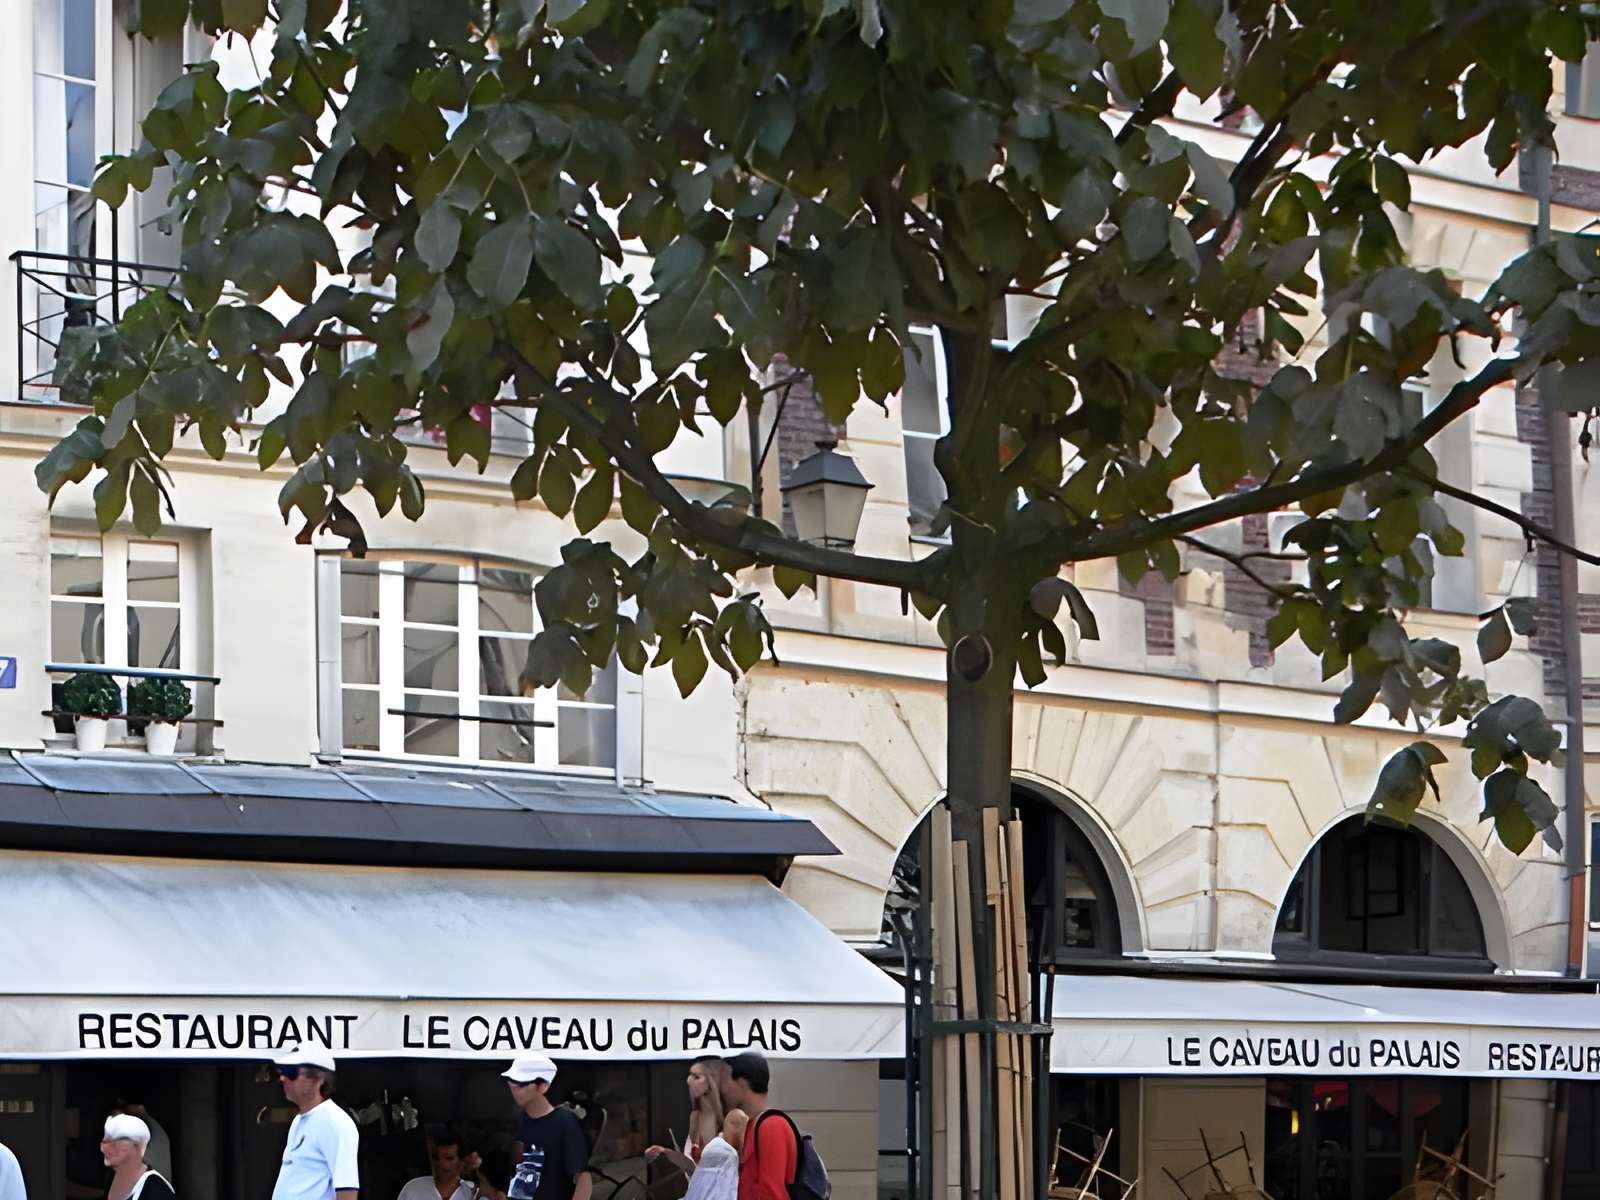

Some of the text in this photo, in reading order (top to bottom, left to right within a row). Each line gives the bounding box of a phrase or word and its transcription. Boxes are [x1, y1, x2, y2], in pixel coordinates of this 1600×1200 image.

[78, 1012, 801, 1052] RESTAURANT LE CAVEAU du PALAIS
[1167, 1036, 1200, 1066] LE
[1209, 1036, 1319, 1067] CAVEAU
[1328, 1039, 1360, 1067] du
[1369, 1039, 1460, 1069] PALAIS
